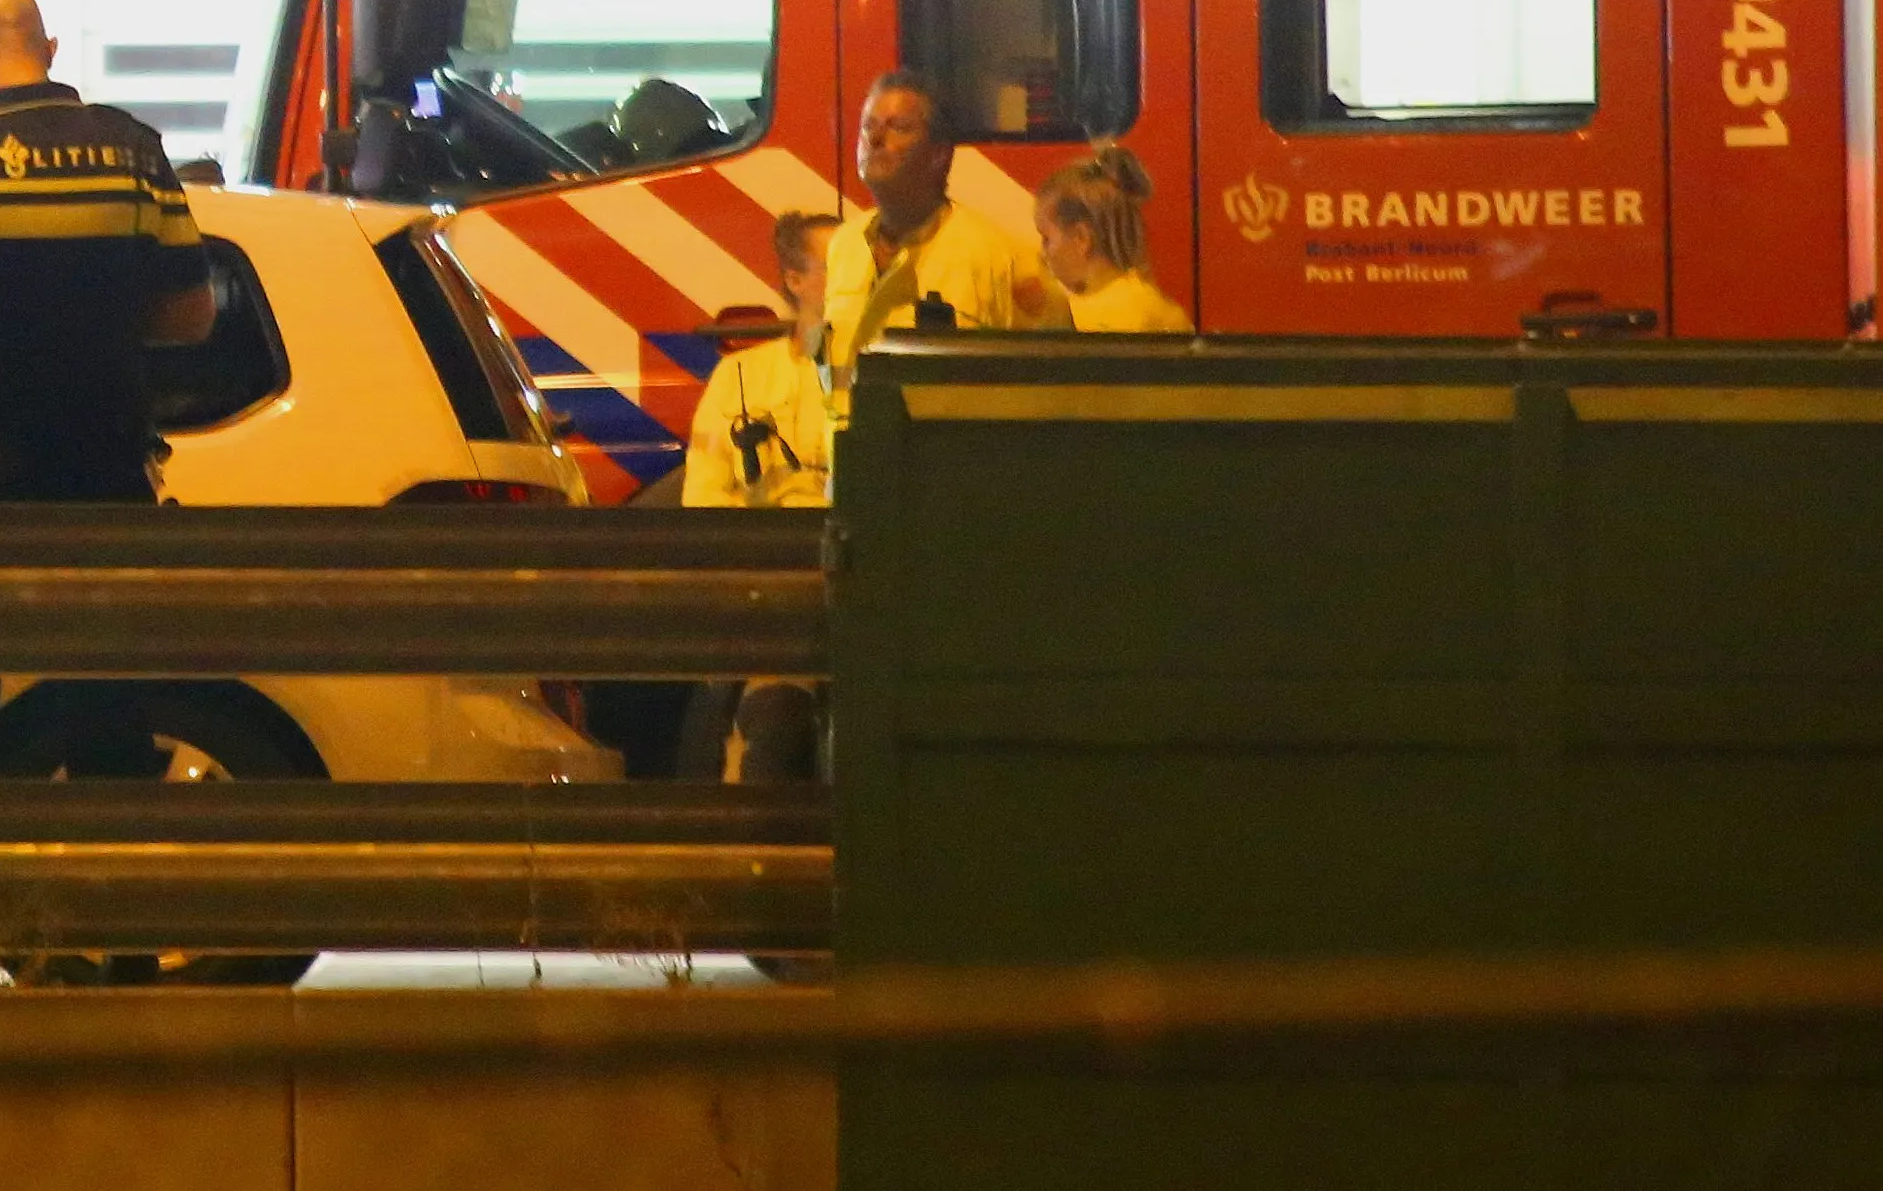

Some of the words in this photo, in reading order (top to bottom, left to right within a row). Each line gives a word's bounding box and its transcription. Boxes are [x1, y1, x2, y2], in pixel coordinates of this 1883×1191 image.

[1304, 189, 1645, 229] BRANDWEER
[1305, 264, 1355, 283] Post
[1365, 263, 1469, 283] Berlicum
